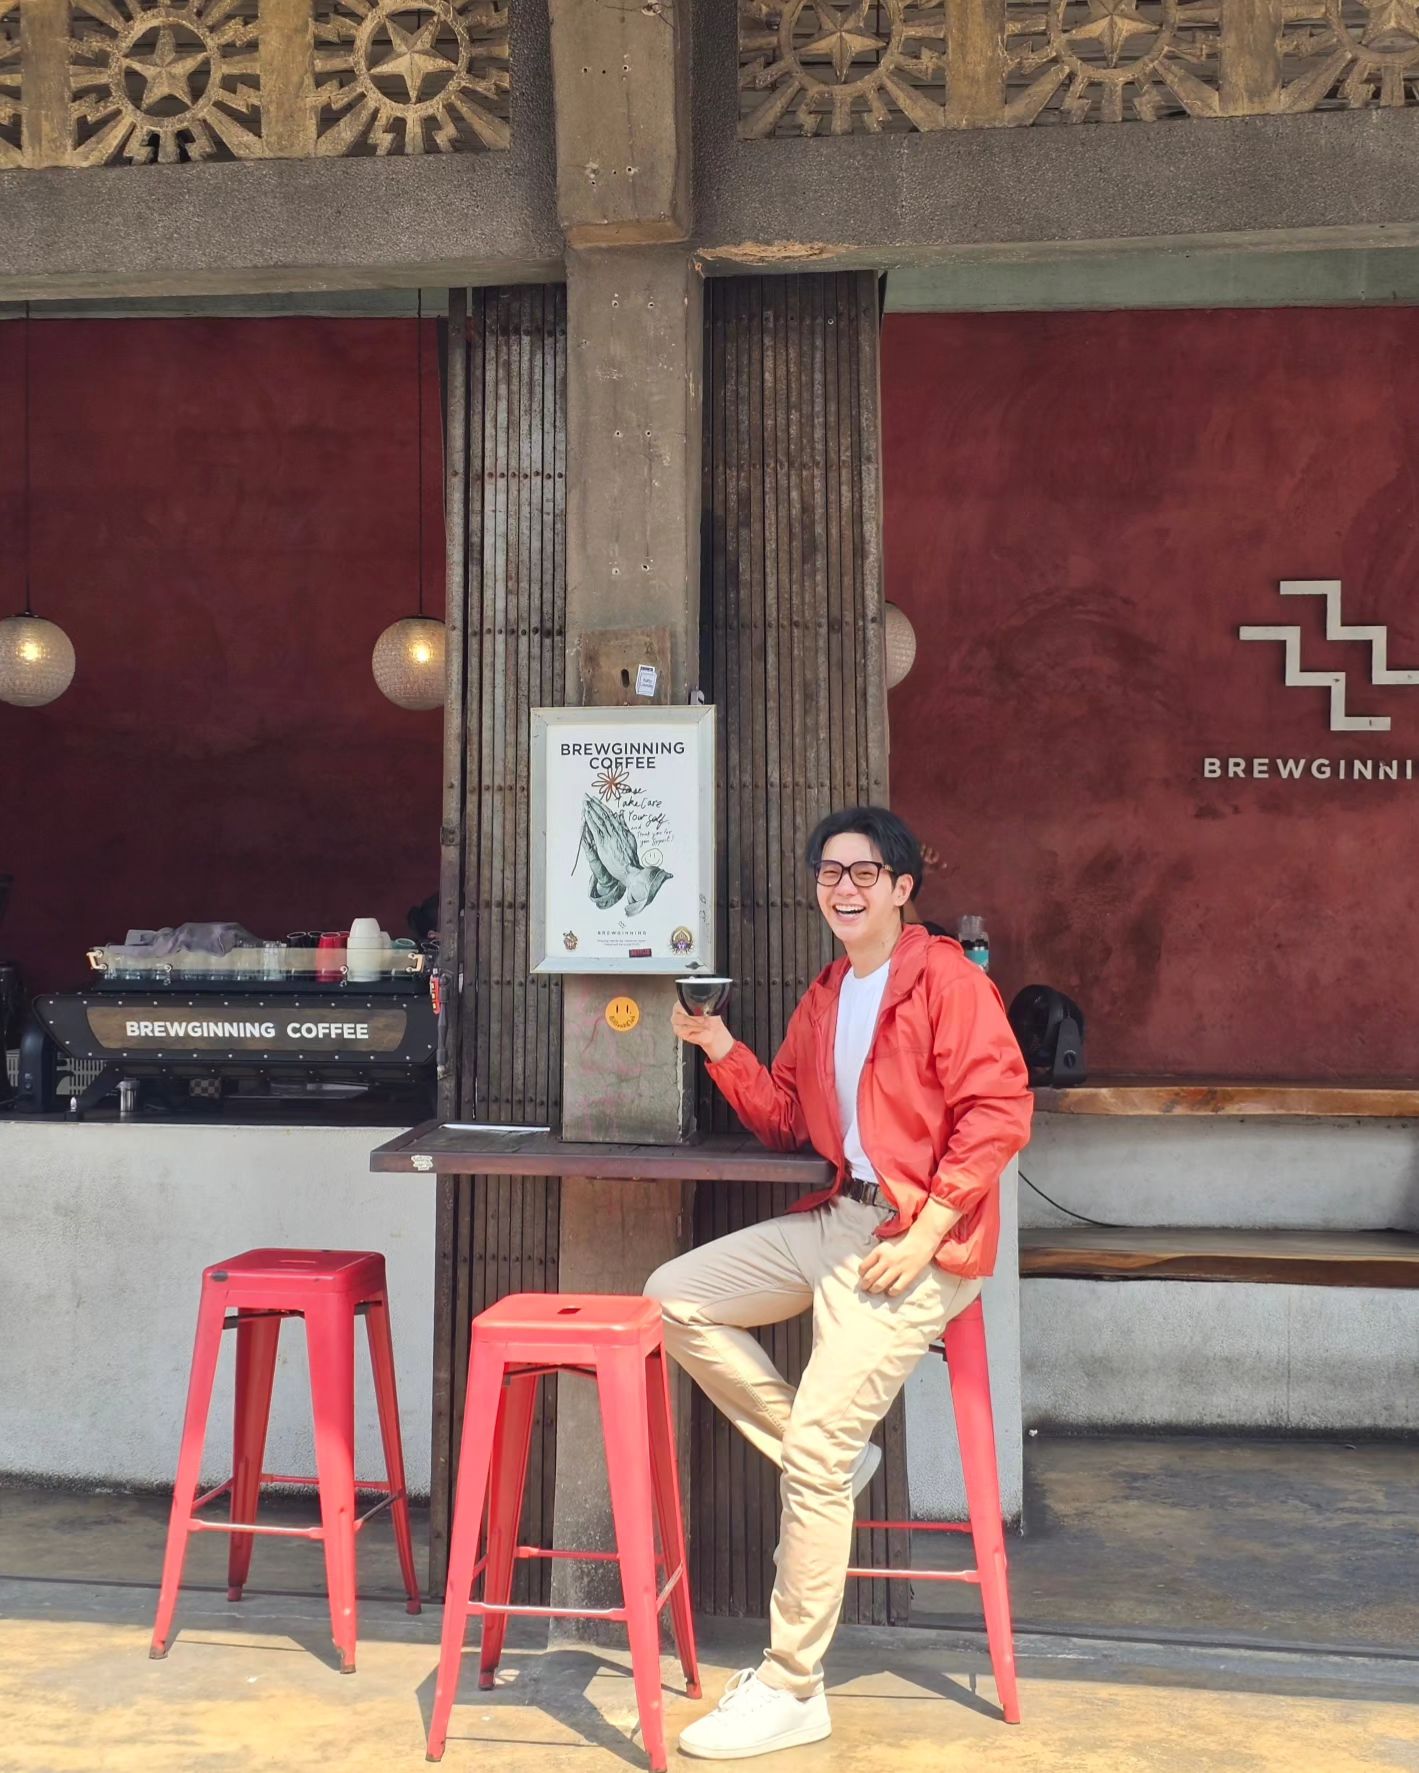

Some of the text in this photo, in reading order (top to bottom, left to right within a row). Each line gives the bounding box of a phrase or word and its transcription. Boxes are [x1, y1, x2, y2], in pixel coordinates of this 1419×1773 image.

[560, 742, 685, 755] BREWGINNING
[589, 757, 656, 769] COFFEE
[1203, 757, 1413, 780] BREWGINNI
[125, 1020, 370, 1039] BREWGINNING COFFEE
